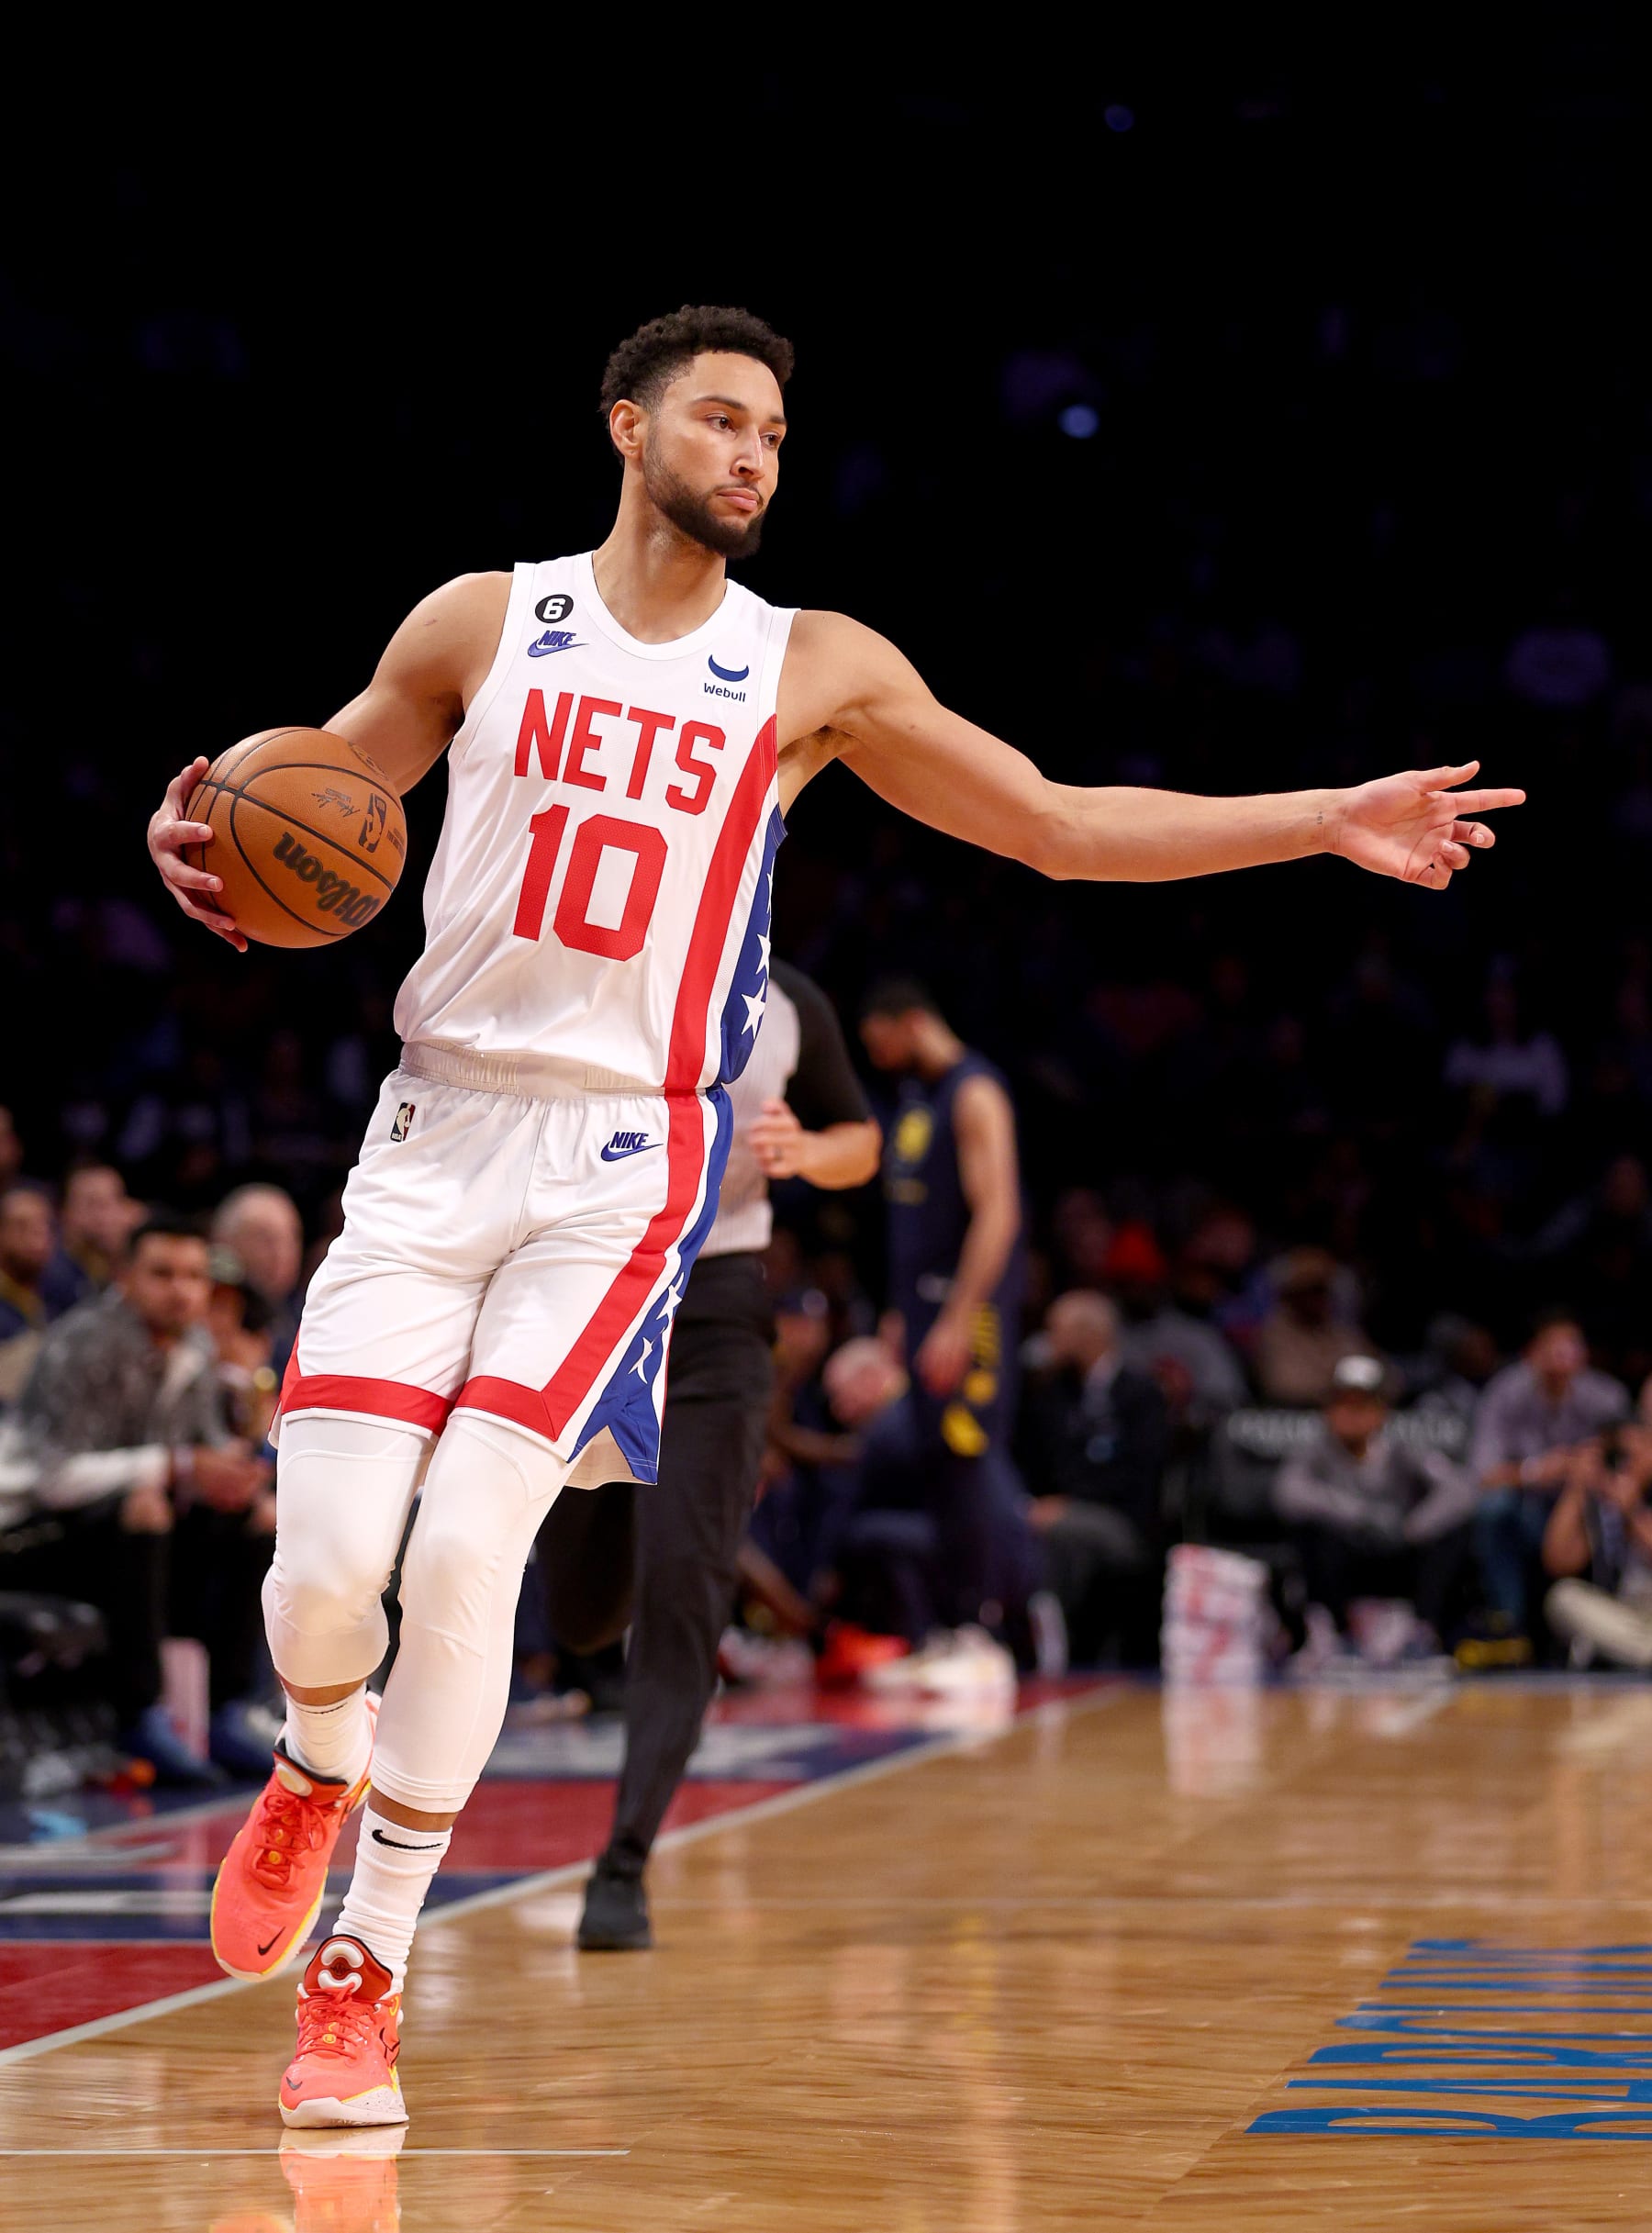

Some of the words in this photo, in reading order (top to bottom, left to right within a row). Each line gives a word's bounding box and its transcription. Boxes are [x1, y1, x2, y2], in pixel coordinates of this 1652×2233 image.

[542, 597, 566, 620] 6
[538, 630, 577, 646] NIKE
[704, 682, 746, 703] Webull
[514, 688, 726, 816] NETS
[273, 832, 381, 927] Wilson
[513, 804, 668, 962] 10
[609, 1131, 649, 1149] NIKE
